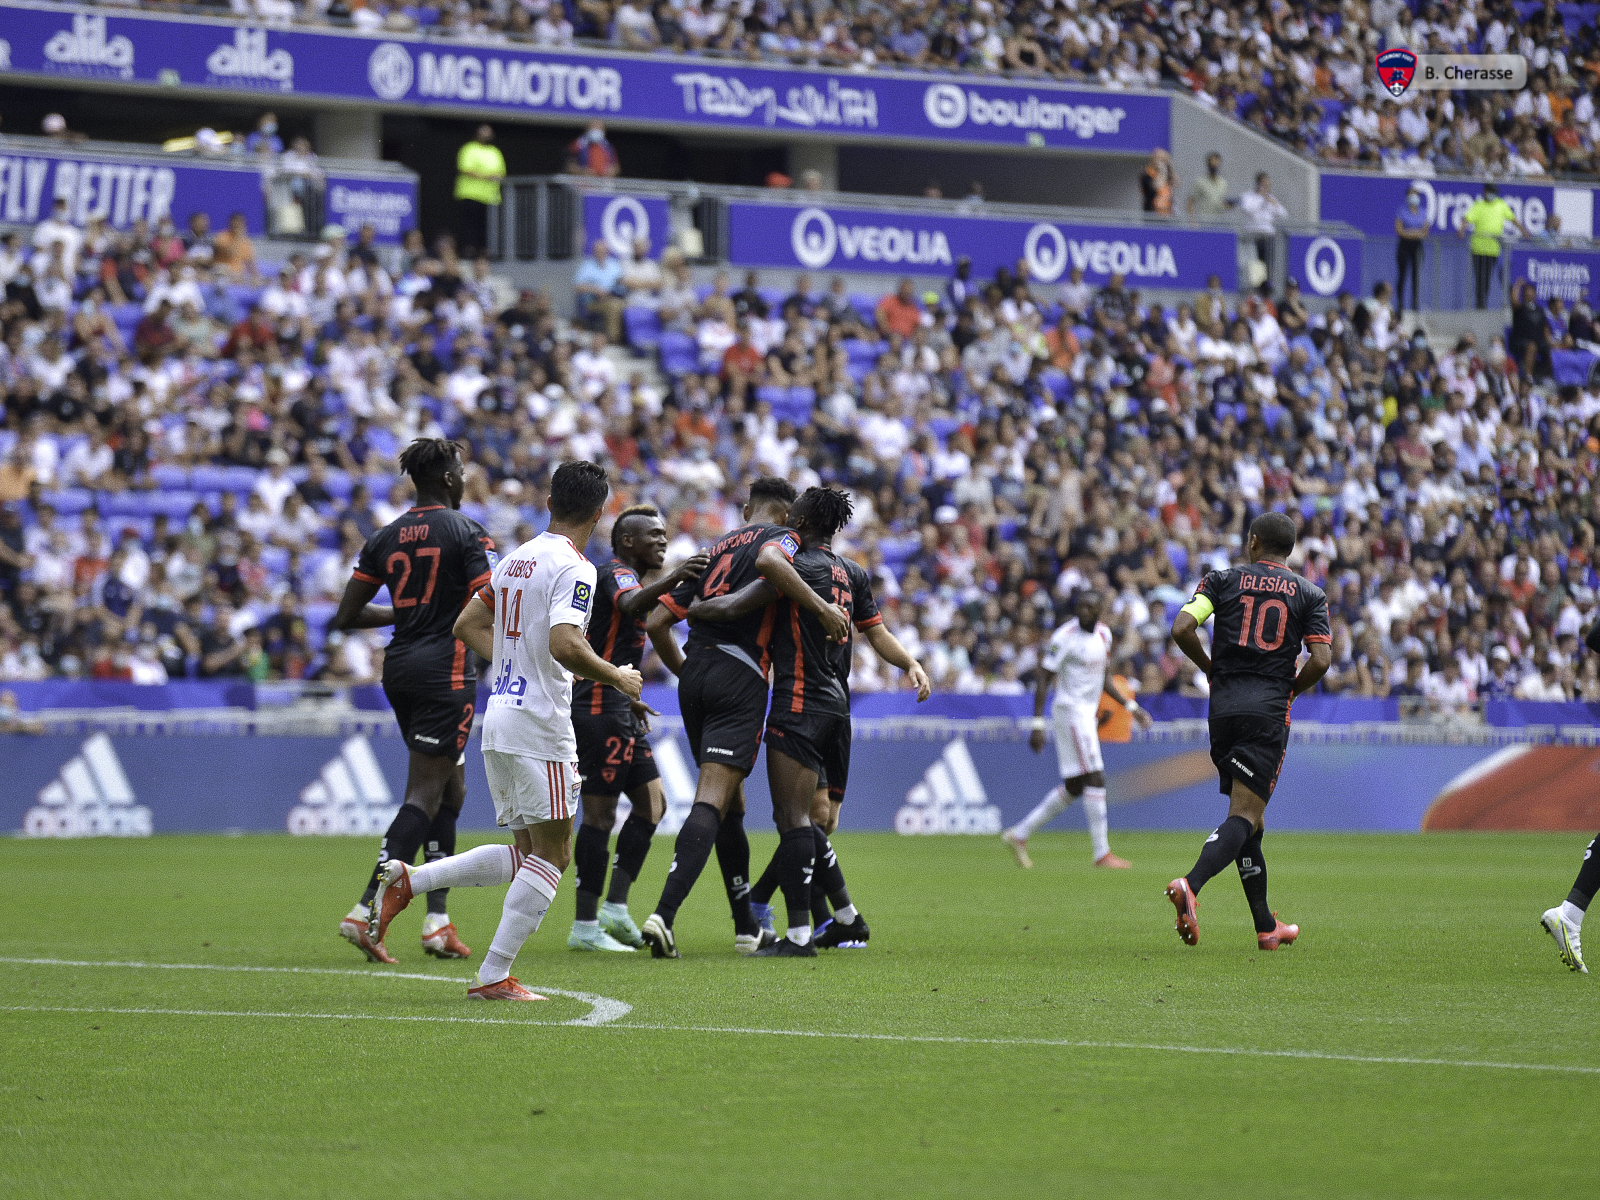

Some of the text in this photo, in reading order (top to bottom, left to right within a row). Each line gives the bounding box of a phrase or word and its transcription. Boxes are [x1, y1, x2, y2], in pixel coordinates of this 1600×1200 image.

[418, 52, 622, 112] MG MOTOR
[968, 92, 1126, 138] boulanger
[1407, 180, 1547, 243] Orage
[838, 224, 952, 265] VEOLIA
[1069, 239, 1178, 278] VEOLIA
[399, 524, 429, 544] BAYO
[386, 547, 441, 609] 27
[704, 553, 734, 597] 4
[501, 587, 523, 650] 14
[1239, 595, 1288, 651] 10
[606, 736, 635, 765] 24
[24, 806, 153, 838] adidas
[894, 805, 1002, 836] adidas
